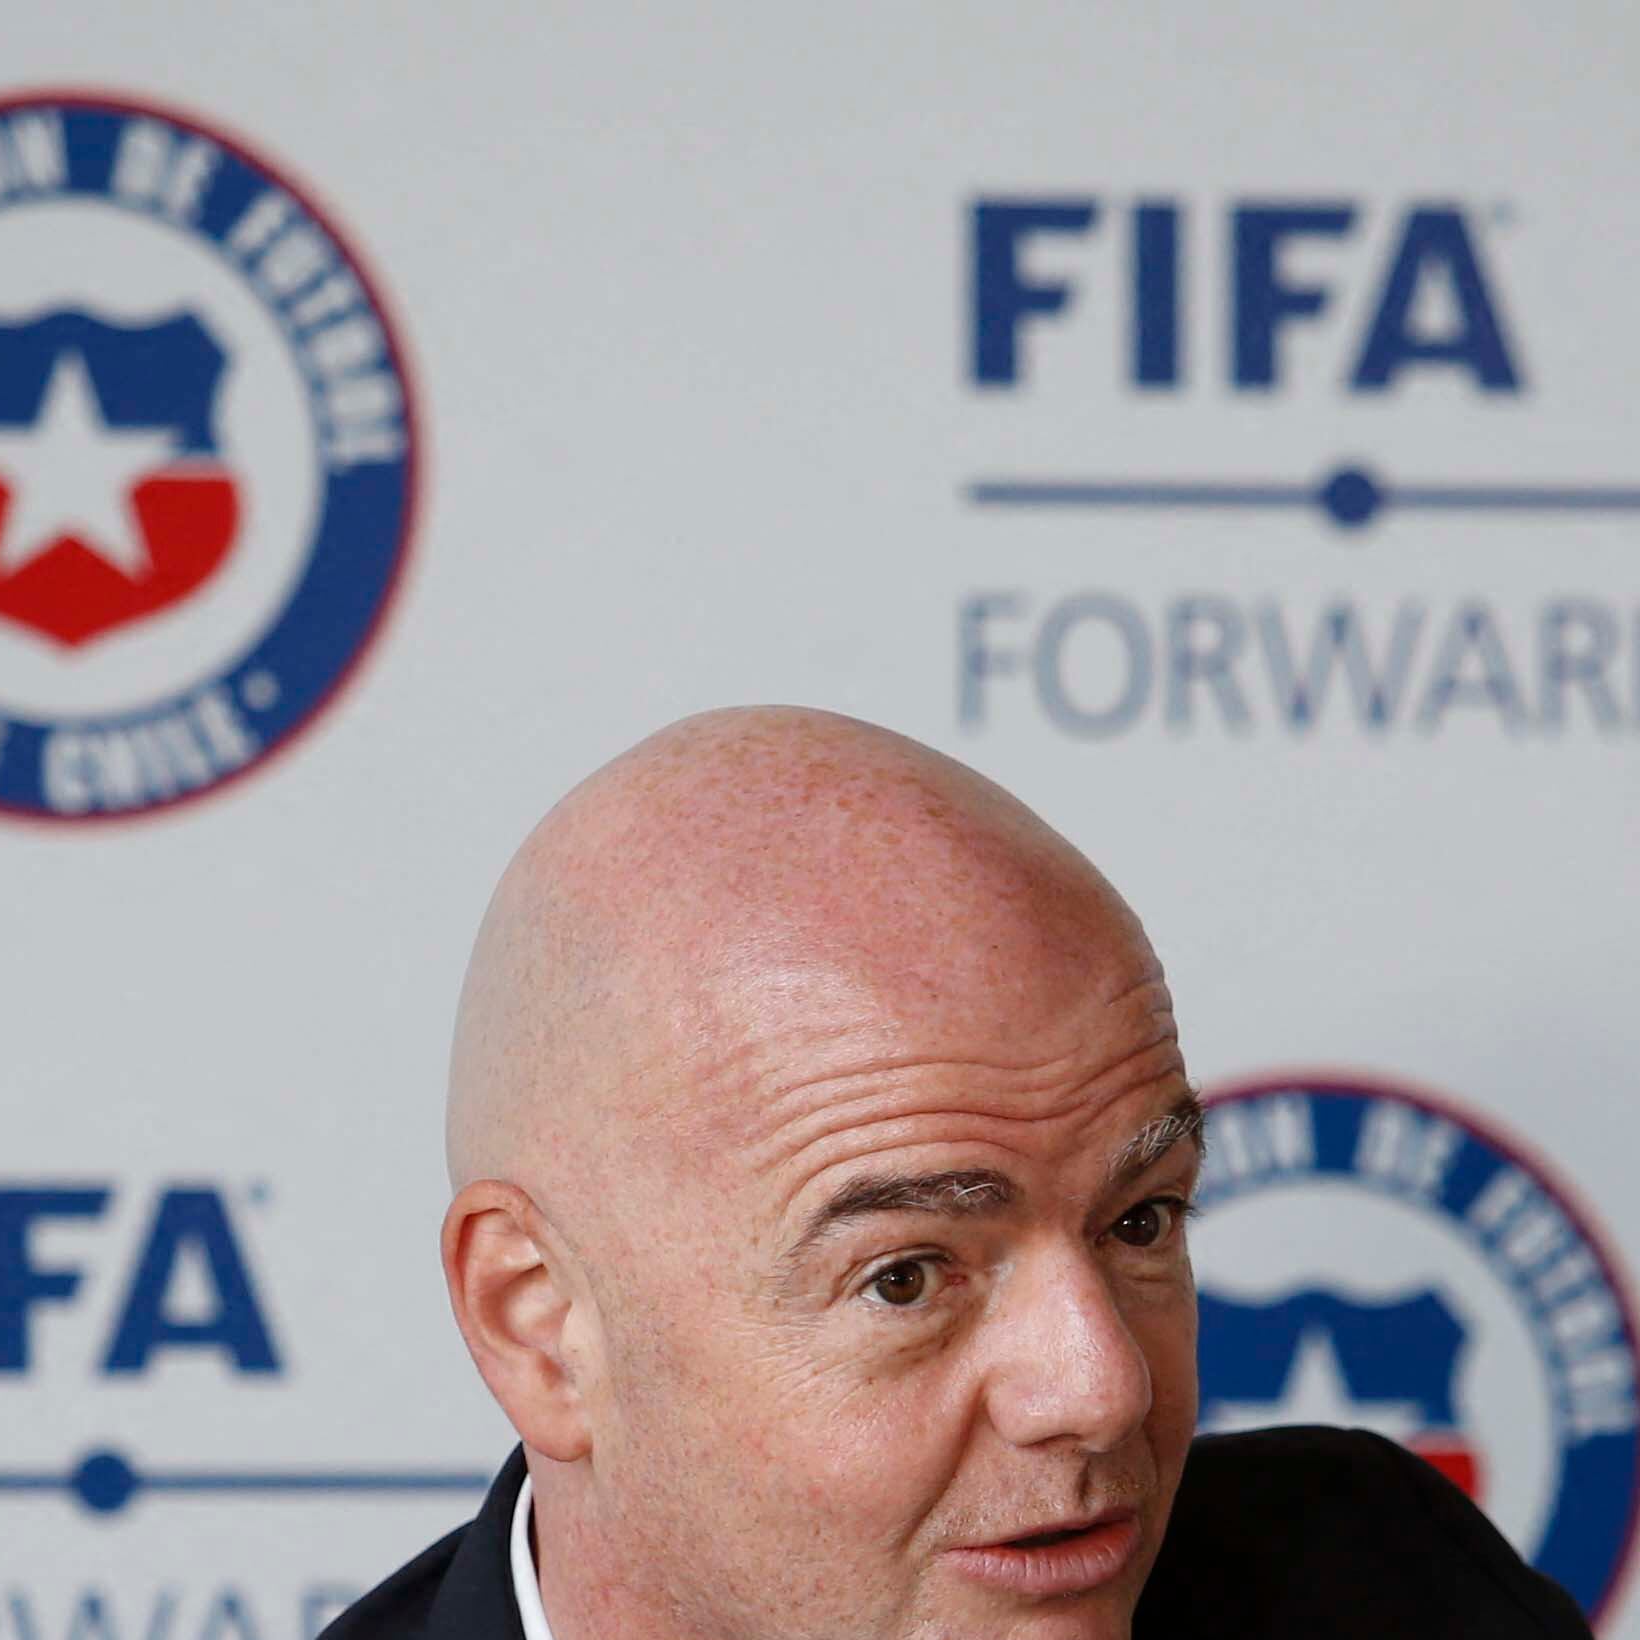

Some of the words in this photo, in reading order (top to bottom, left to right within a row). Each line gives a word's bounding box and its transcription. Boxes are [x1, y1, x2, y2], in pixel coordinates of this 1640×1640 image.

[110, 116, 222, 230] DE
[224, 187, 408, 476] FUTBOL
[964, 196, 1532, 396] FIFA
[41, 683, 257, 814] CHILE
